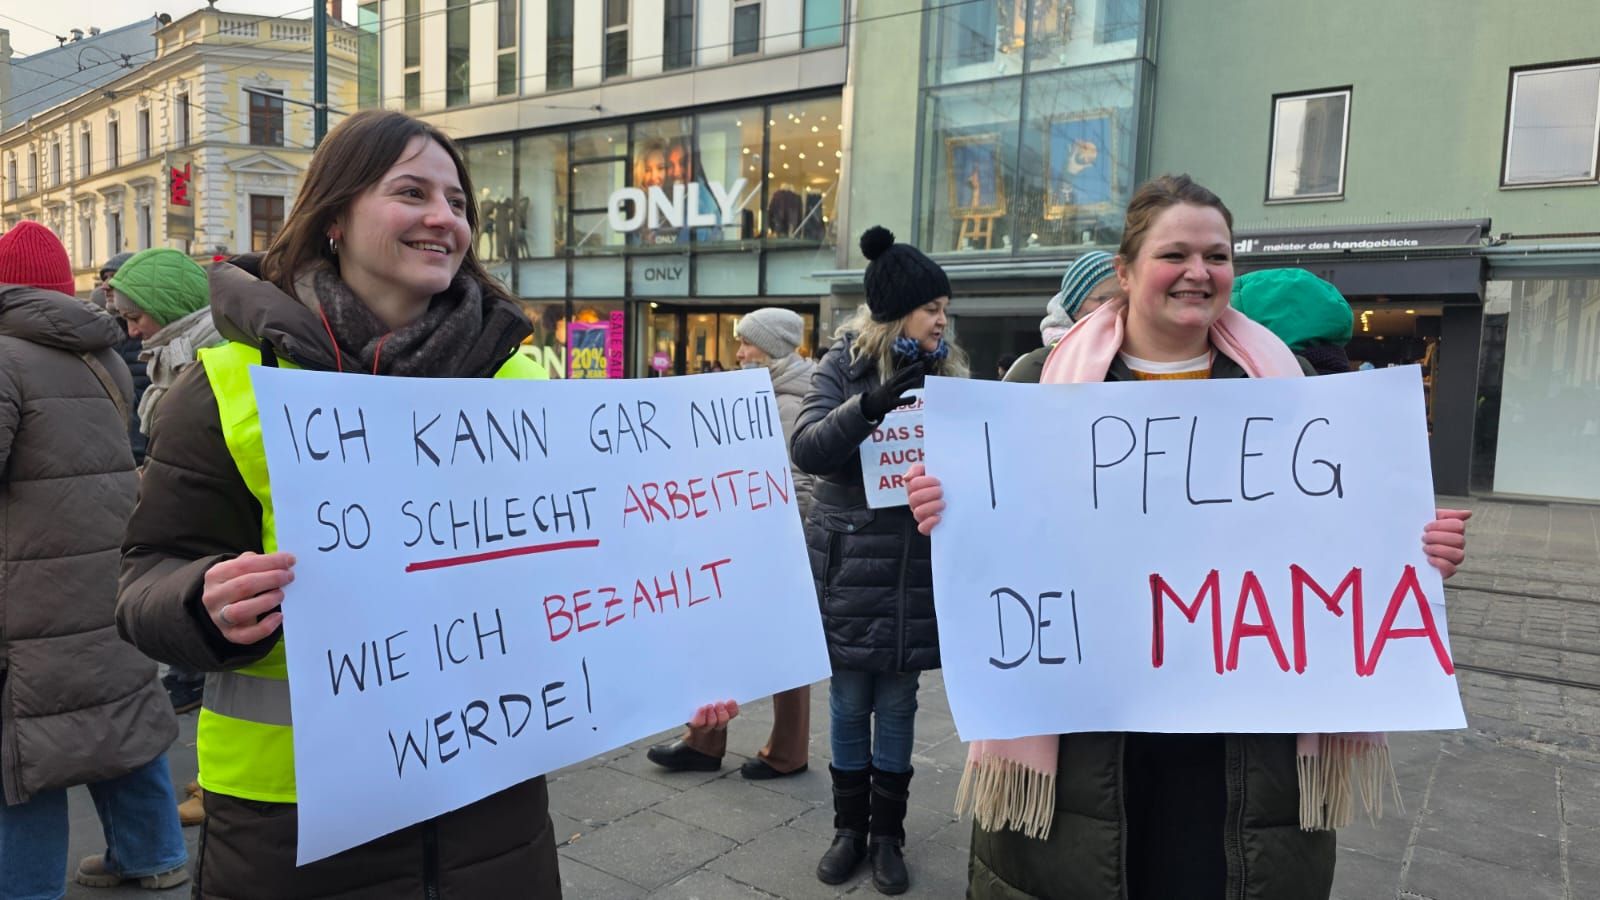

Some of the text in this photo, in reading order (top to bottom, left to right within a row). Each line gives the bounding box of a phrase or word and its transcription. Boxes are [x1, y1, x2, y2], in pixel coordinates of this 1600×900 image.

[608, 178, 747, 232] ONLY
[644, 267, 683, 281] ONLY
[1263, 242, 1306, 252] meister
[1308, 241, 1331, 250] des
[1333, 238, 1418, 249] handgebäcks
[572, 348, 607, 369] 20%
[284, 390, 774, 467] ICH KANN GAR NICHT
[871, 426, 910, 443] DAS
[985, 415, 1344, 514] I PFLEG
[317, 466, 789, 552] SO SCHLECHT ARBEITEN
[328, 558, 732, 696] WIE ICH BEZAHLT
[989, 563, 1456, 679] DEI MAMA
[388, 655, 599, 780] WERDE!
